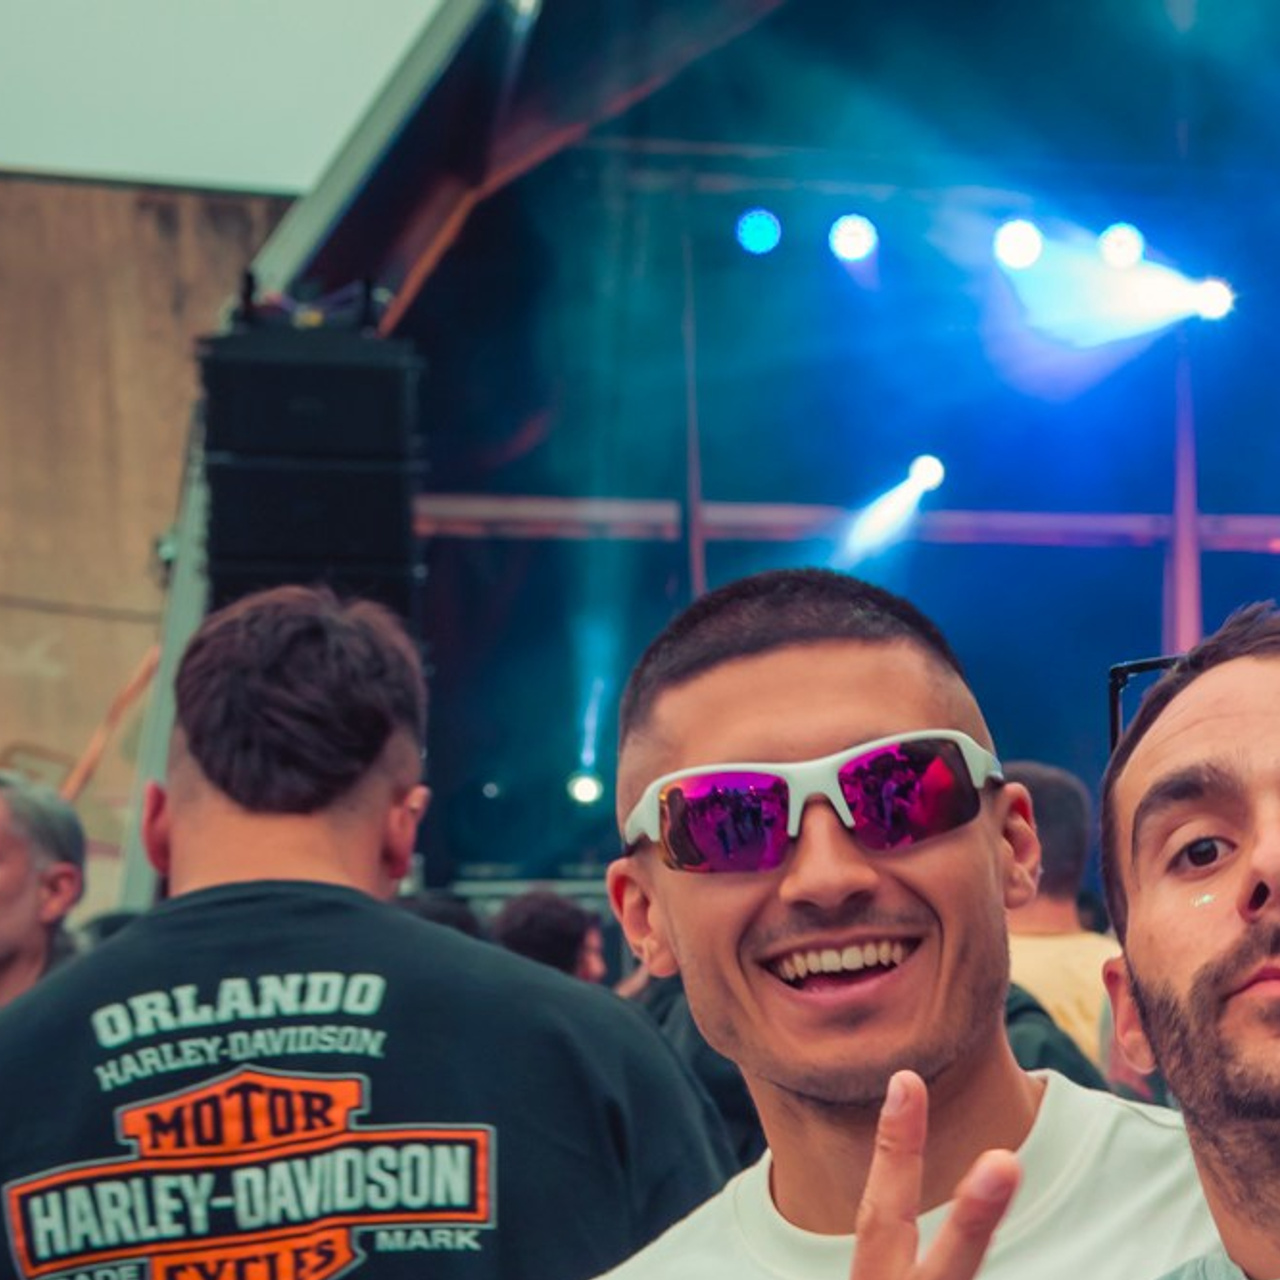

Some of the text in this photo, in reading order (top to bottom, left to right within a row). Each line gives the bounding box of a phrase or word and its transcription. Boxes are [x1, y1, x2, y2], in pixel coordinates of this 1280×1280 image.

[91, 972, 386, 1048] ORLANDO
[95, 1025, 387, 1091] HARLEY-DAVIDSON
[145, 1080, 336, 1151] MOTOR
[28, 1144, 472, 1260] HARLEY-DAVIDSON
[375, 1229, 481, 1252] MARK
